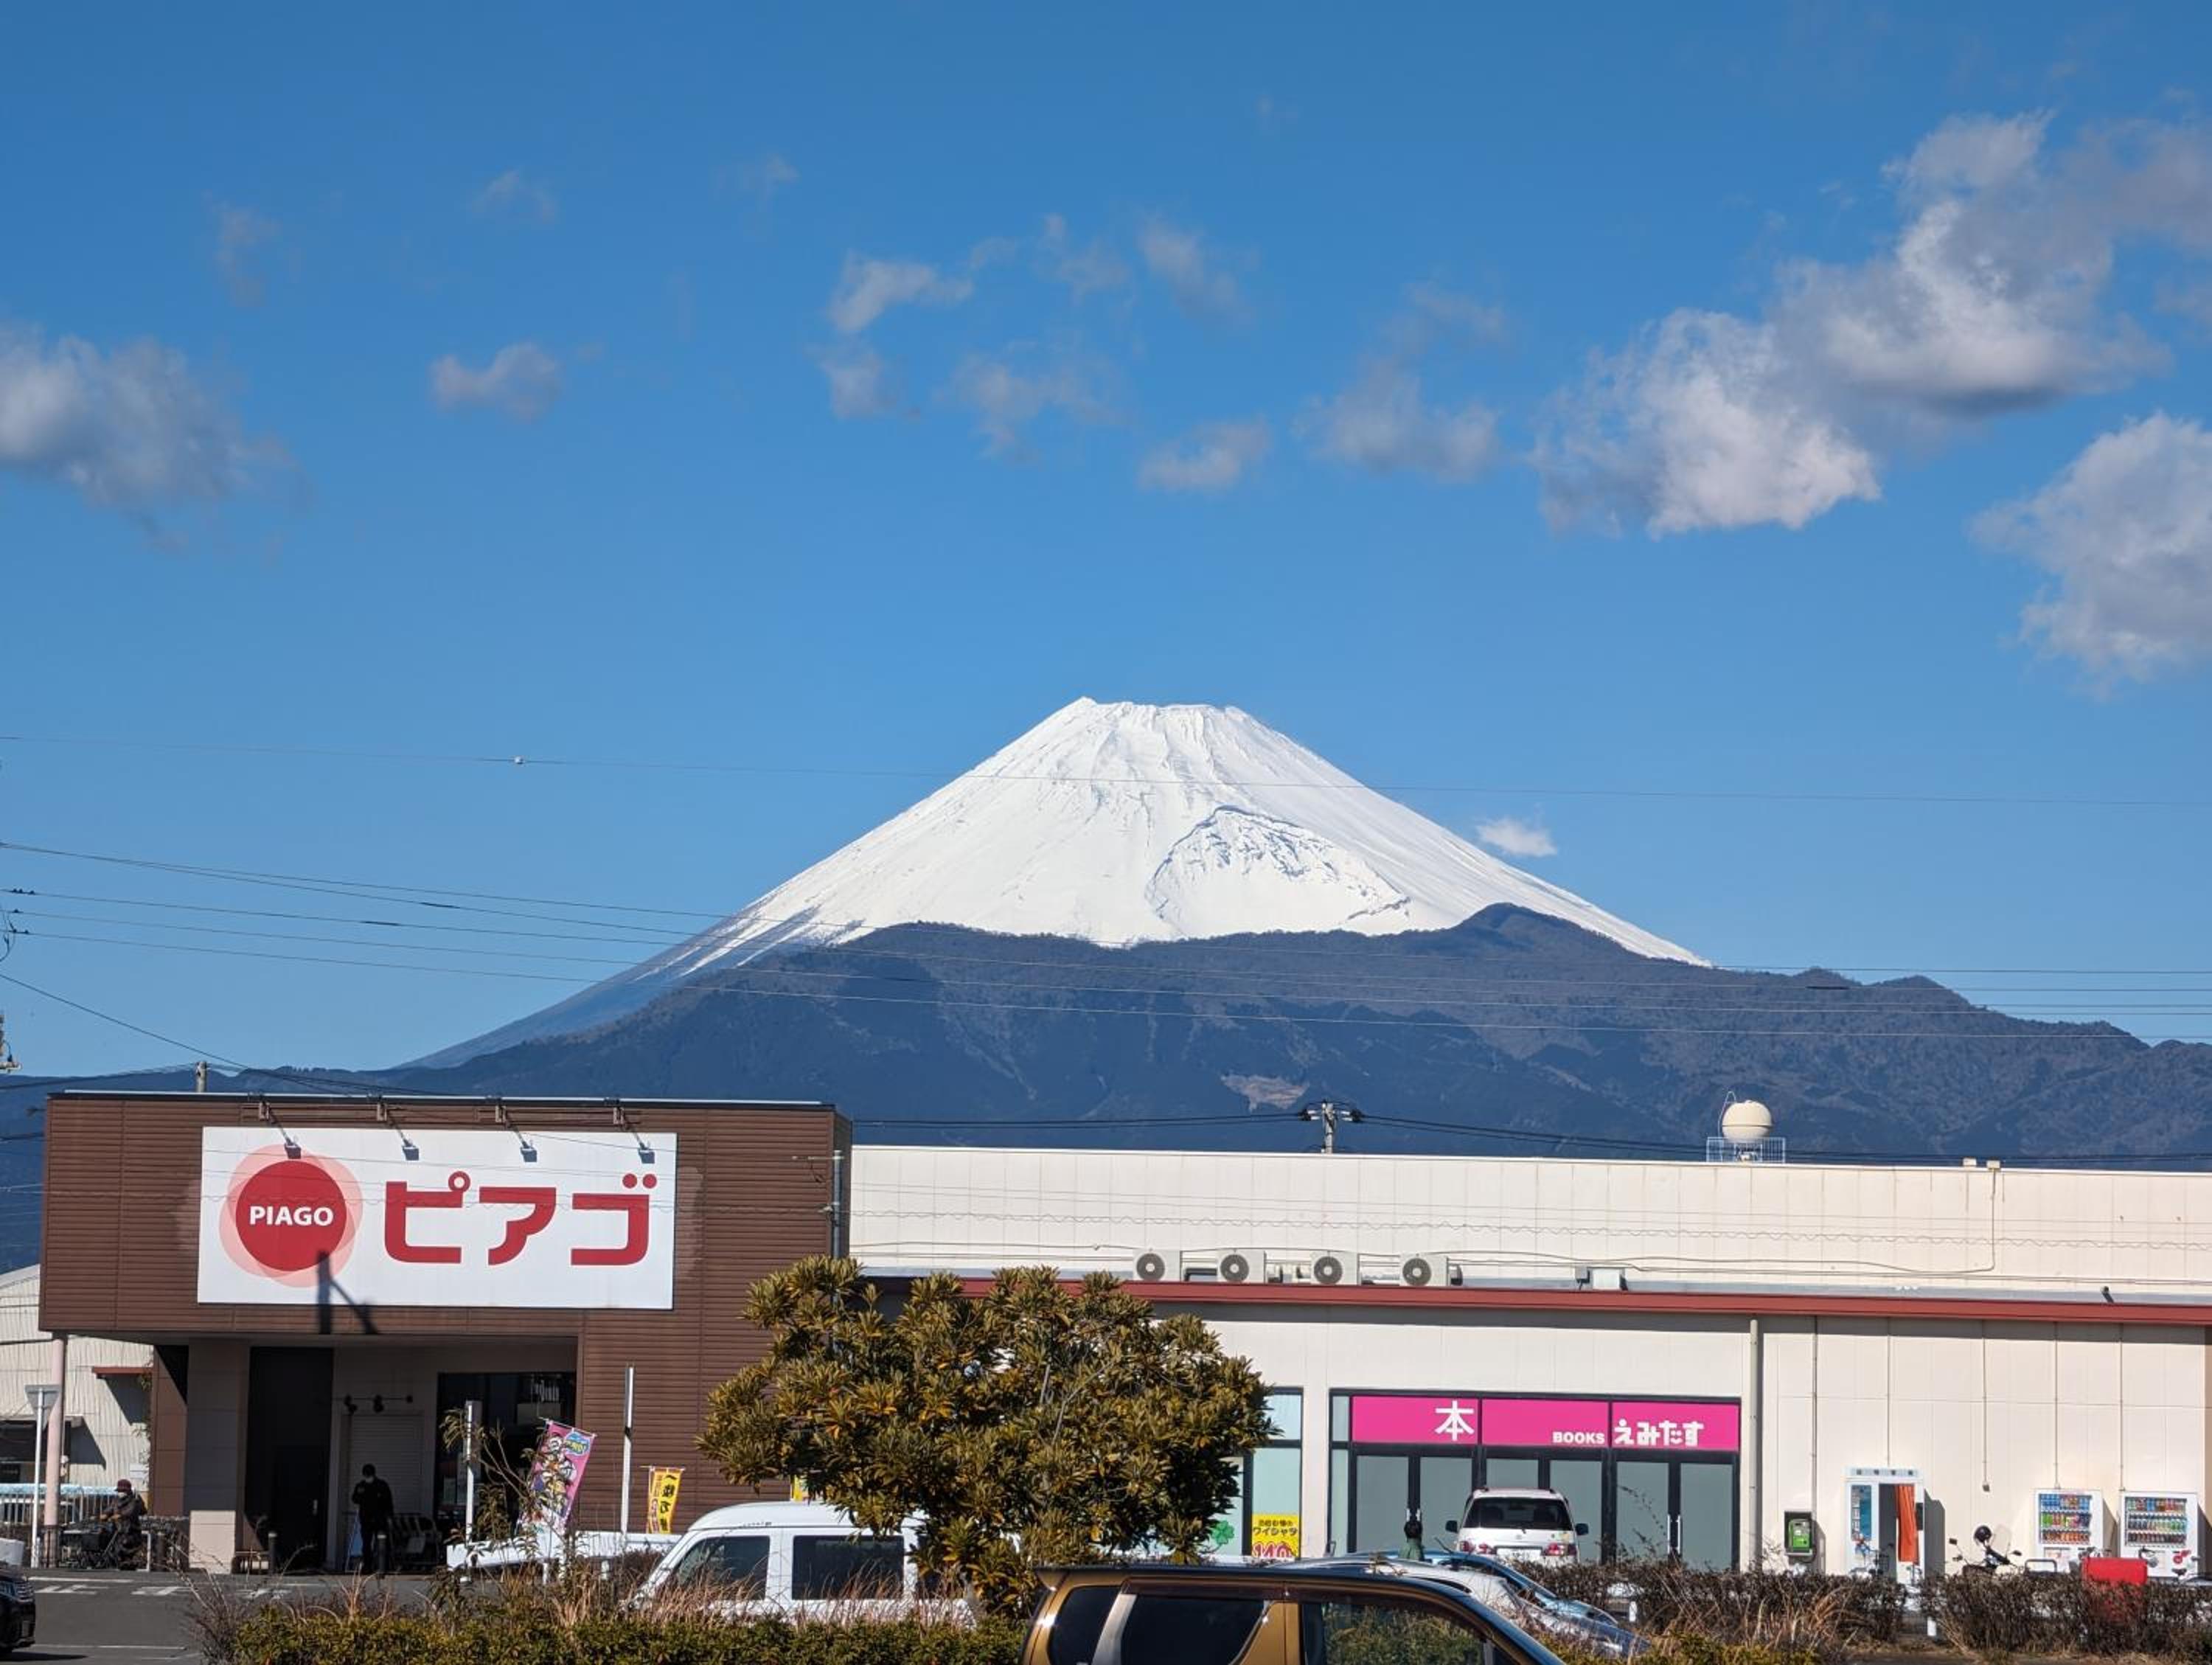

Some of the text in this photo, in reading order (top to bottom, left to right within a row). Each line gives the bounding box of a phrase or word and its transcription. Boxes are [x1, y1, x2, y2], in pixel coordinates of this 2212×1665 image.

[249, 1207, 334, 1226] PIAGO
[384, 1170, 658, 1266] ピアゴ
[1435, 1400, 1474, 1442] 本
[1552, 1419, 1704, 1446] BOOKS えみたす
